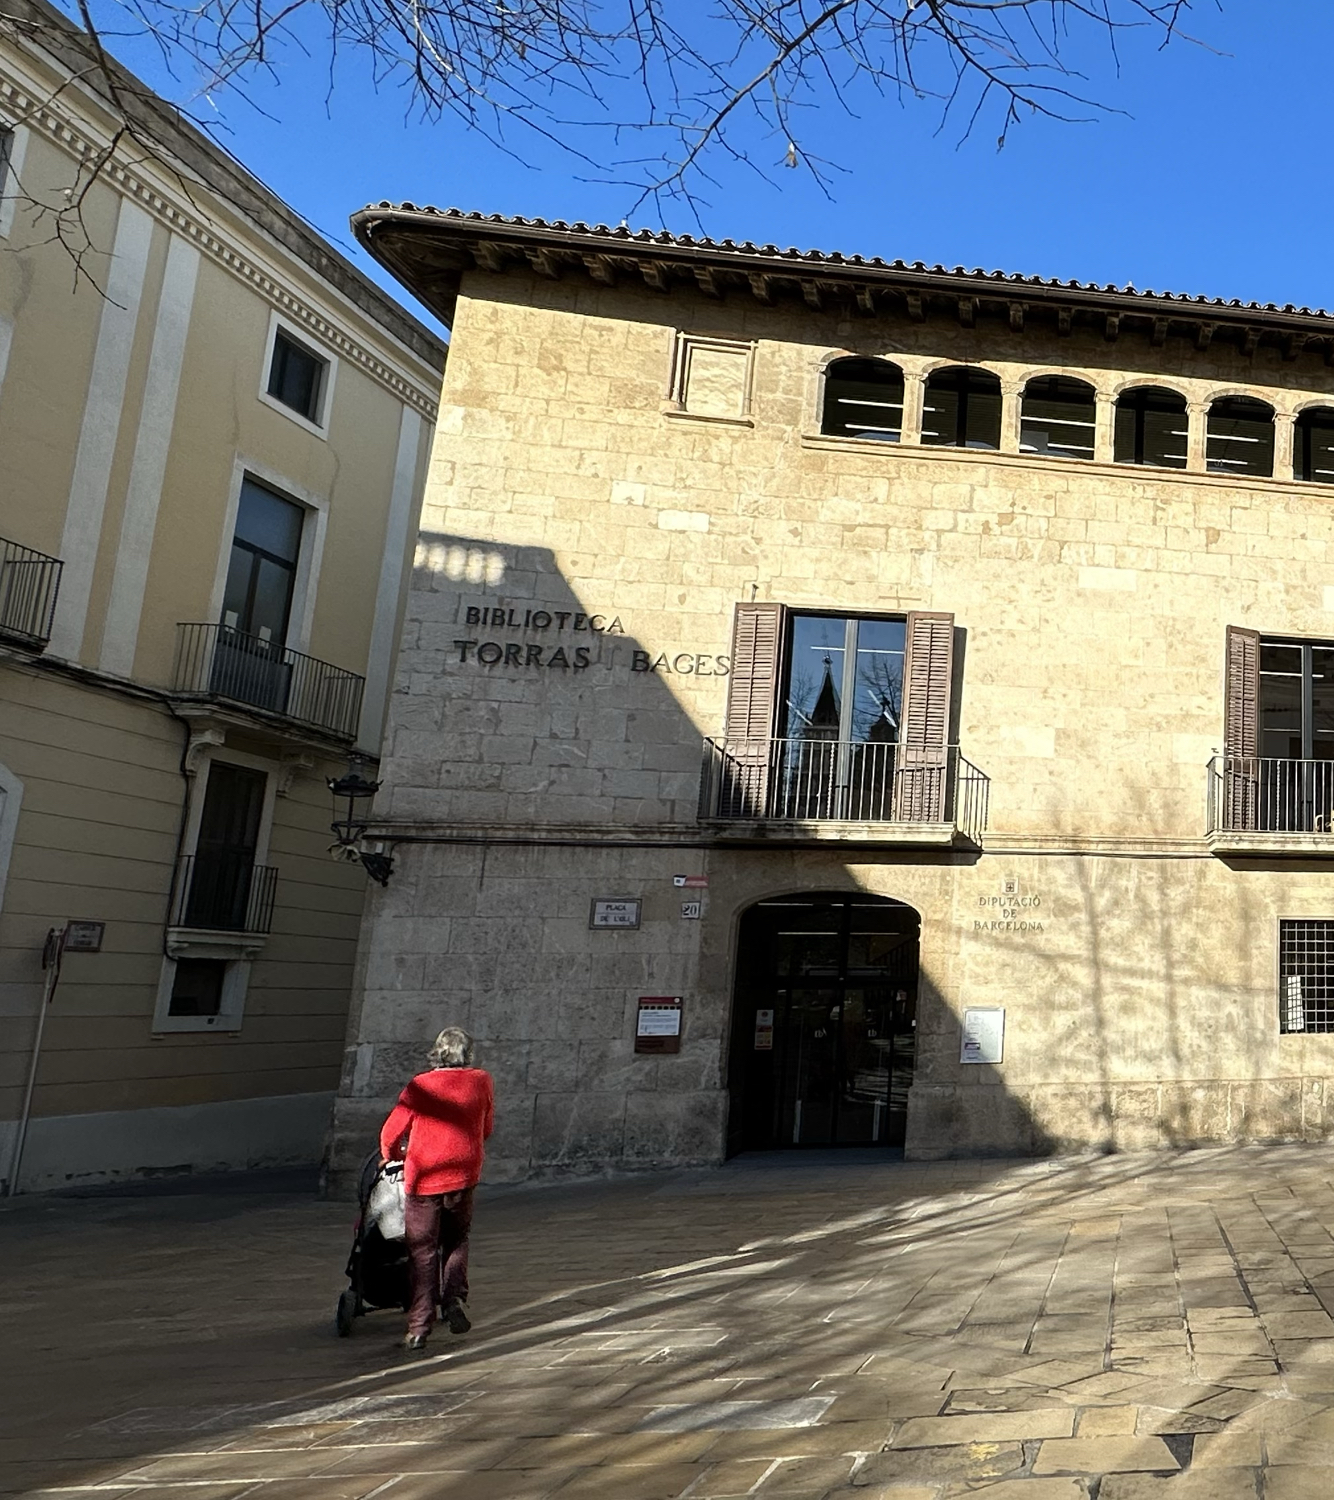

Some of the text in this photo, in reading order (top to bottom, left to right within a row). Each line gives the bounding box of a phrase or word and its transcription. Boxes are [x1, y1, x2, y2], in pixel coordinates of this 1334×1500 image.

[465, 606, 626, 634] BIBLIOTECA
[453, 639, 591, 669] TORRAS
[630, 650, 731, 677] BAGES
[979, 894, 1041, 907] DIPUTACIÓ
[682, 904, 697, 916] 20
[1002, 908, 1017, 919] DE
[973, 920, 1045, 931] BARCELONA
